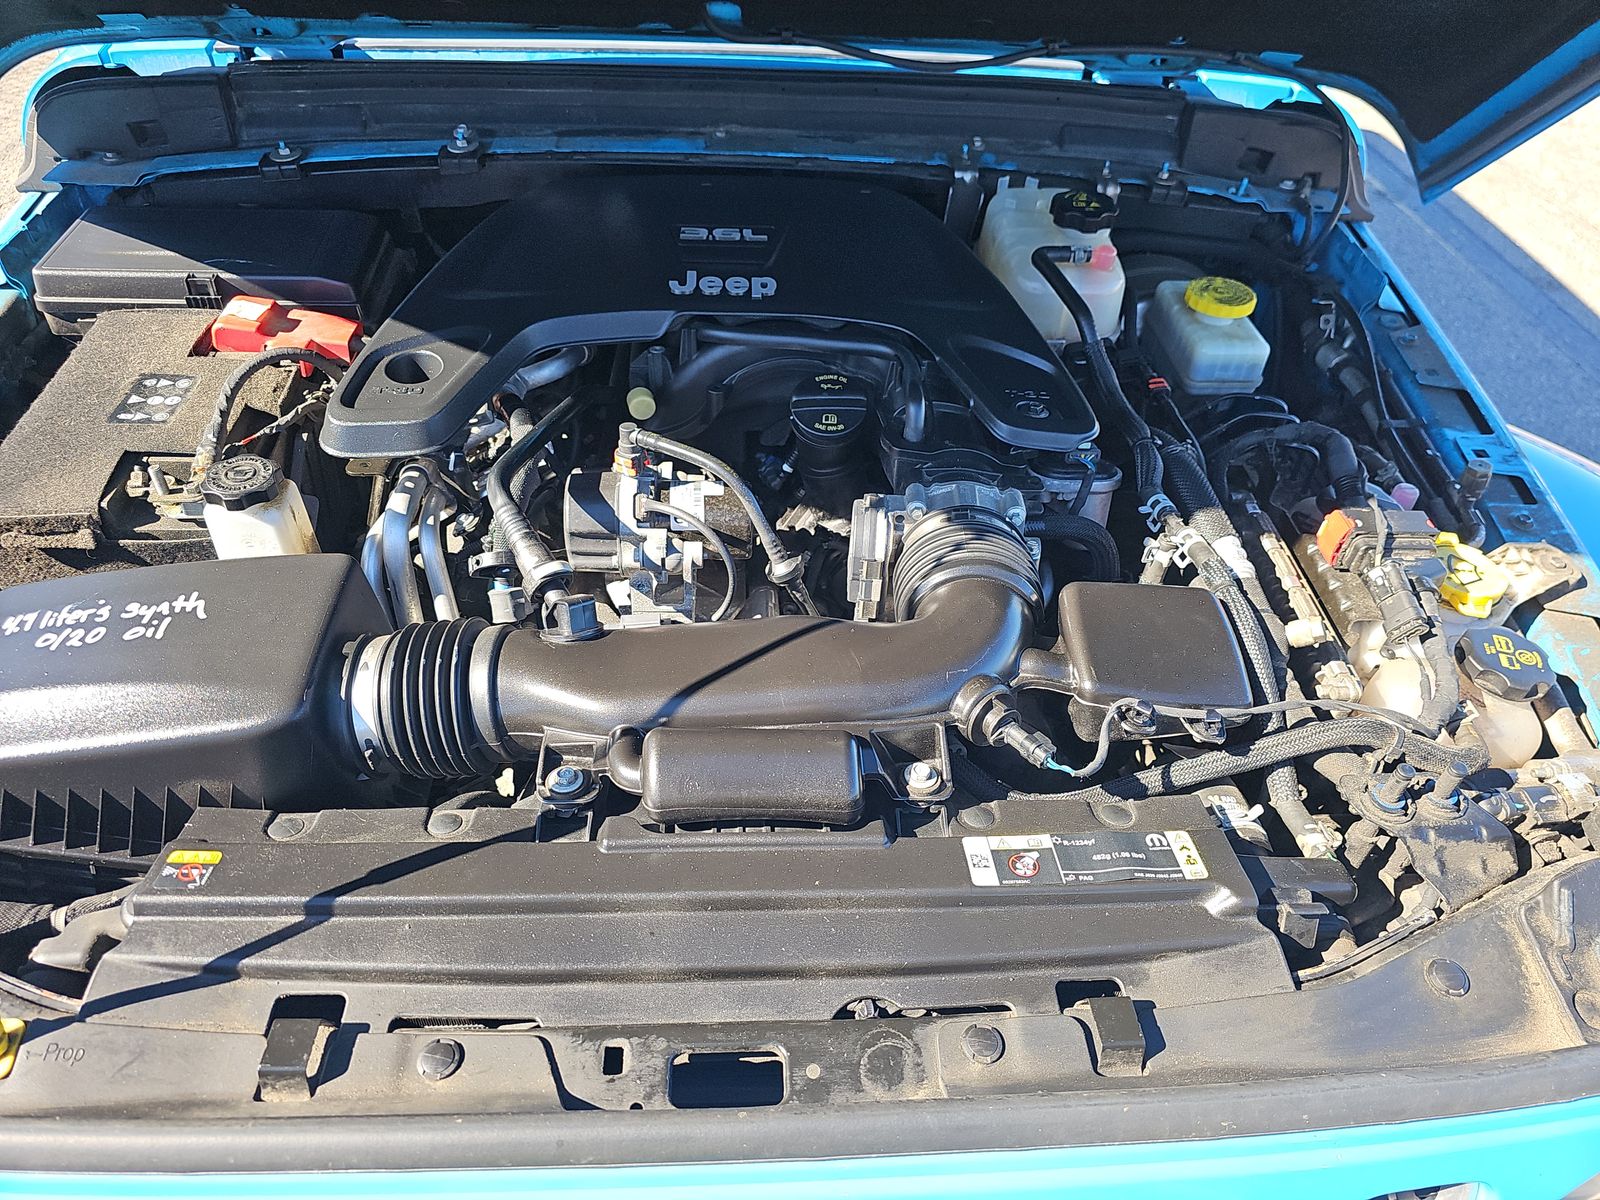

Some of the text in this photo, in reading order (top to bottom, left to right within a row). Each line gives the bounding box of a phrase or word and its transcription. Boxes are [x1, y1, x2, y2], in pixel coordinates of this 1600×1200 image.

[679, 226, 769, 242] 3.6L
[668, 269, 778, 300] Jeep
[814, 374, 849, 384] ENGINE OIL
[814, 422, 826, 431] SAE
[34, 625, 108, 651] 0/20
[42, 1042, 86, 1068] Prop
